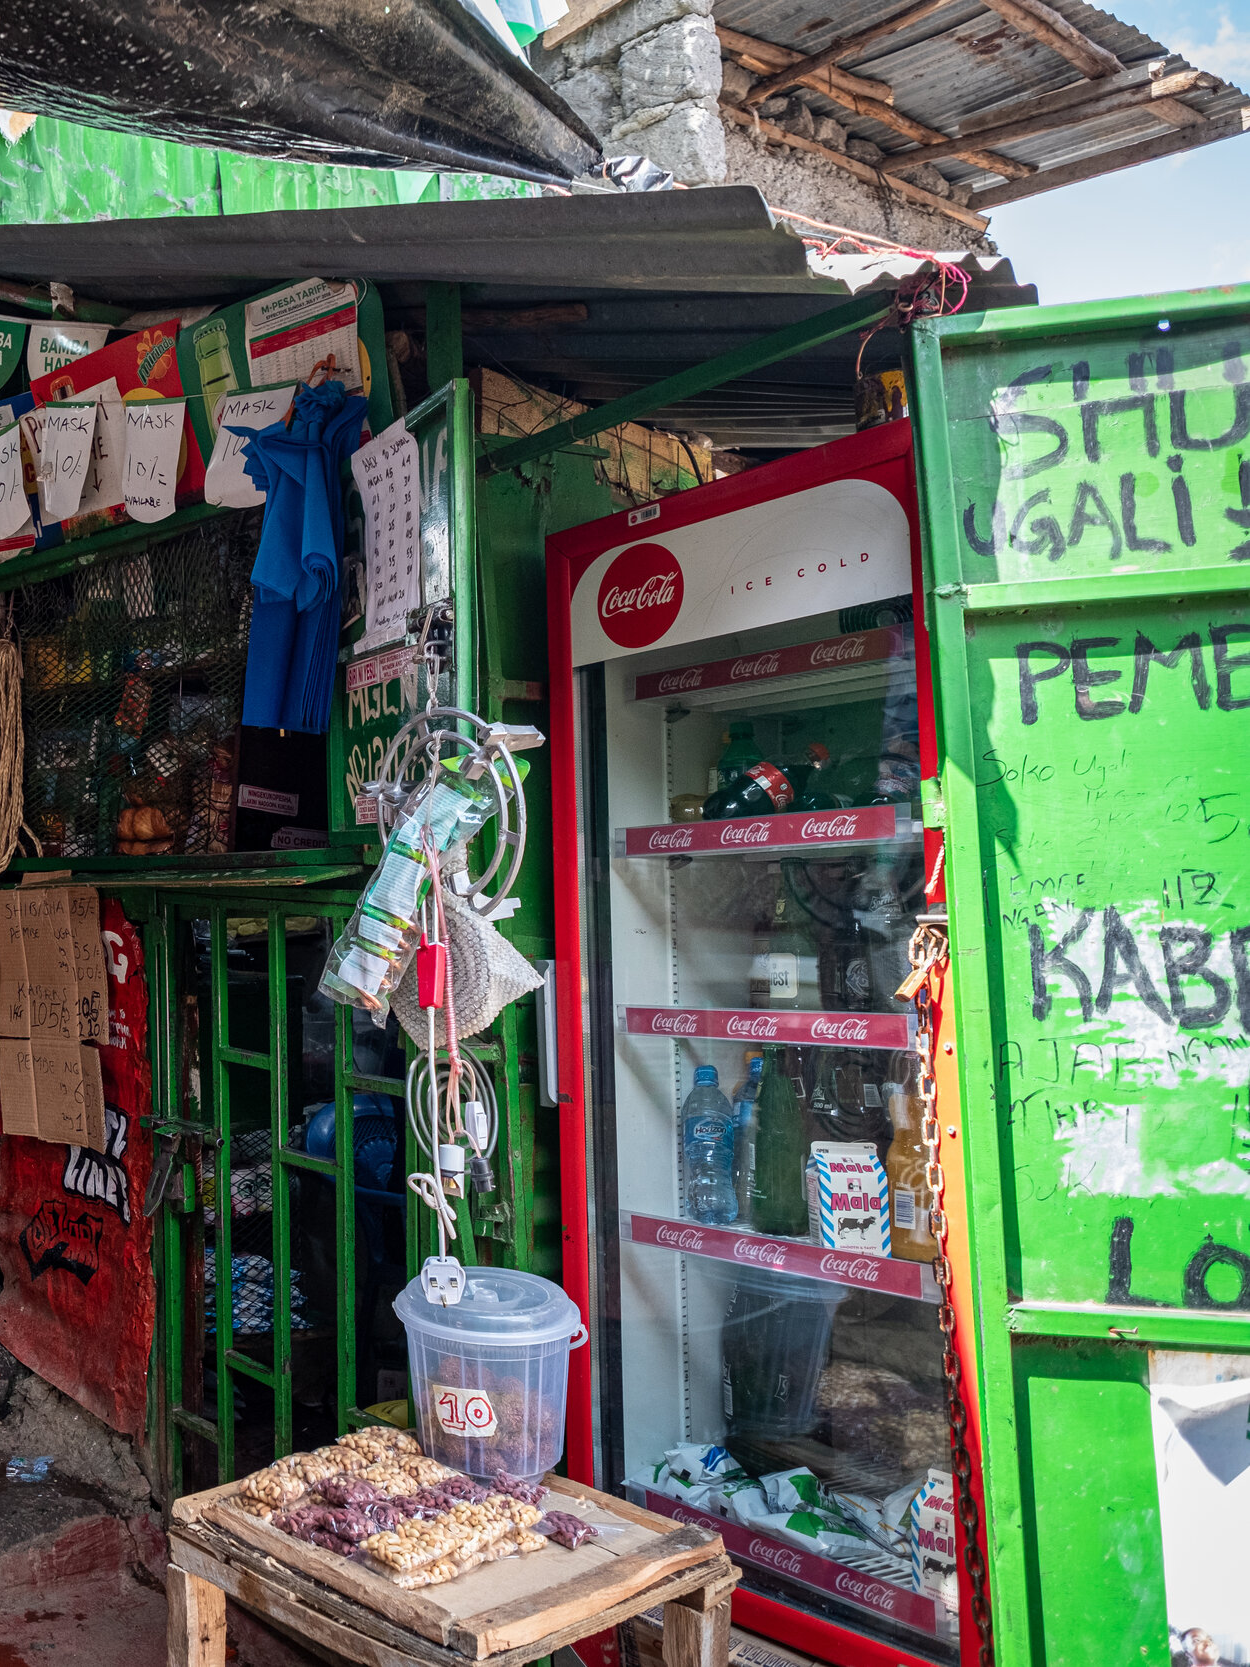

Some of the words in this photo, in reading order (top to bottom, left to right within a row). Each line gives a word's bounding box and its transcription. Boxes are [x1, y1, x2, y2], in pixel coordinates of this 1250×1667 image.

[261, 295, 296, 315] M-PESA
[296, 282, 331, 300] TARIFF
[40, 337, 89, 355] BAMBA
[44, 356, 79, 372] HAP
[127, 412, 175, 430] MASK
[223, 400, 277, 421] MASK
[47, 415, 91, 434] MASK
[730, 576, 773, 595] ICE
[797, 552, 870, 578] COLD
[601, 570, 679, 618] Coca-Cola
[810, 636, 870, 665] Coca-Cola
[730, 652, 783, 680] Coca-Cola
[720, 821, 773, 845] Coca-Cola
[801, 813, 860, 839] Coca-Cola
[277, 836, 291, 845] NO
[648, 828, 695, 850] Coca-Cola
[770, 969, 790, 988] rest
[651, 1012, 699, 1034] Coca-Cola
[726, 1015, 781, 1037] Coca-Cola
[810, 1017, 871, 1041] Coca-Cola
[829, 1162, 874, 1174] Mala
[830, 1192, 882, 1212] Mala
[655, 1224, 704, 1250] Coca-Cola
[733, 1237, 789, 1265] Coca-Cola
[820, 1252, 881, 1282] Coca-Cola
[438, 1391, 494, 1432] 10
[923, 1494, 955, 1516] Ma
[918, 1527, 955, 1558] Mal
[749, 1538, 805, 1574] Coca-Cola
[834, 1571, 897, 1610] Coca-Cola
